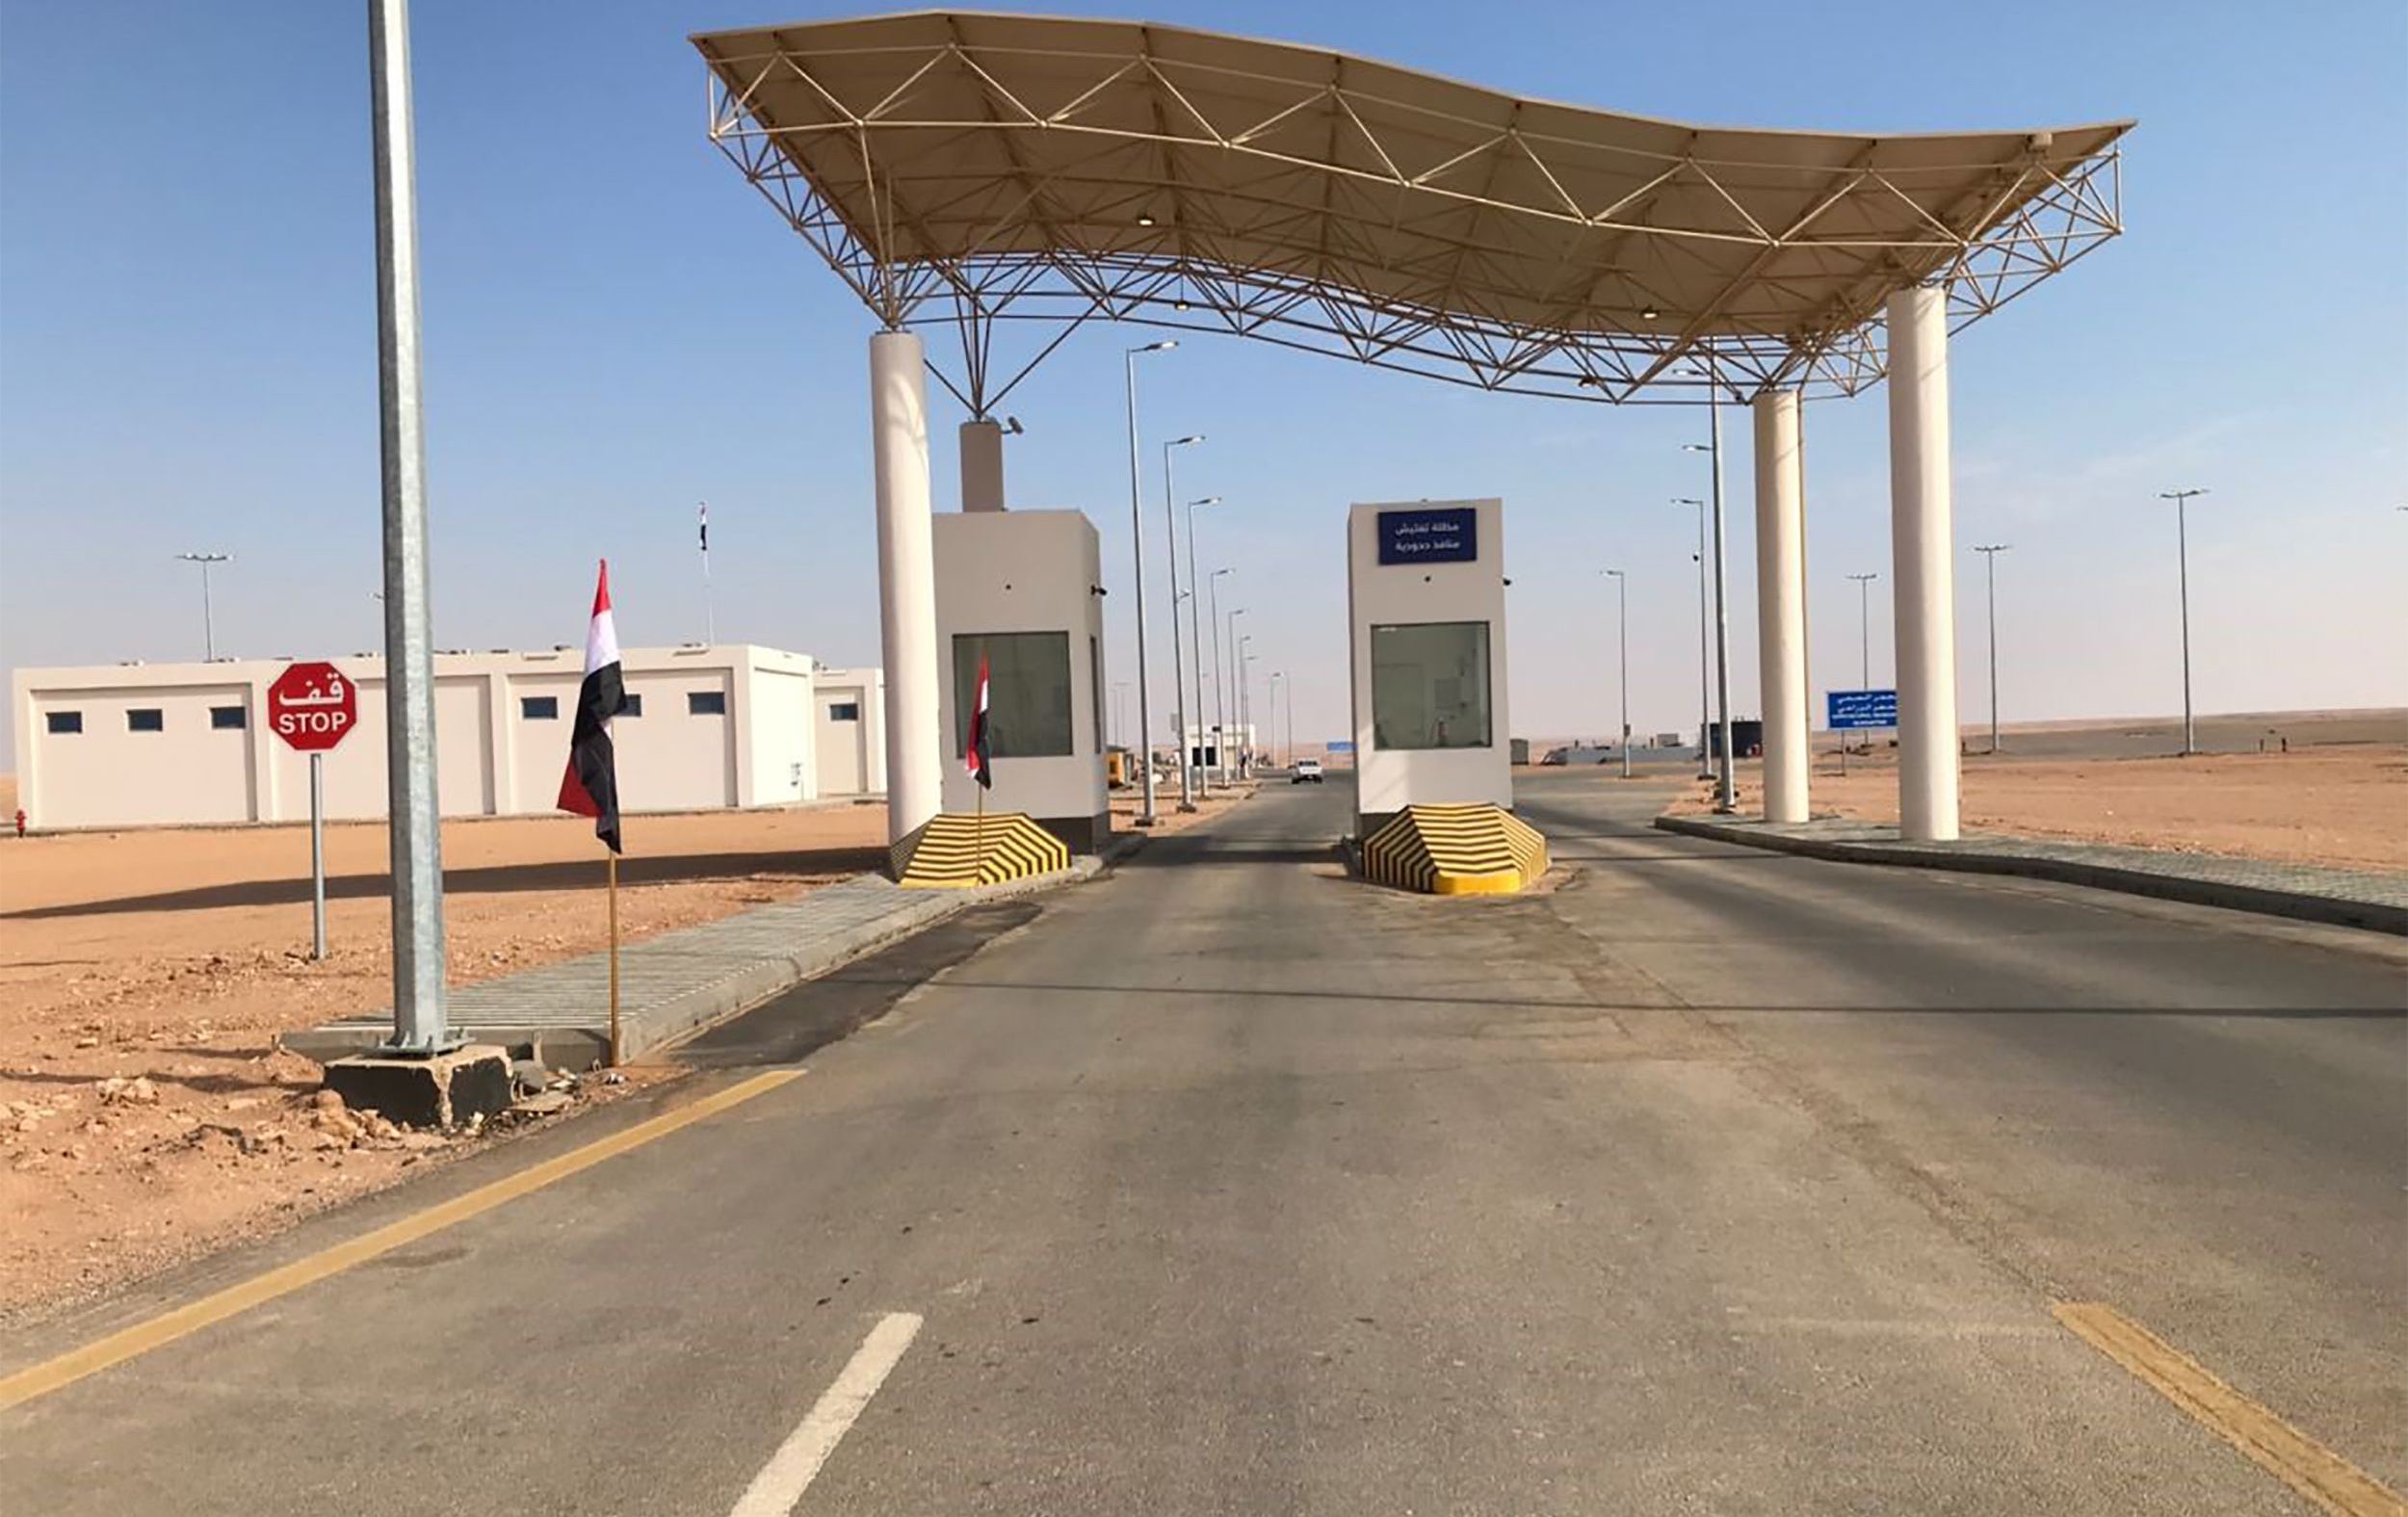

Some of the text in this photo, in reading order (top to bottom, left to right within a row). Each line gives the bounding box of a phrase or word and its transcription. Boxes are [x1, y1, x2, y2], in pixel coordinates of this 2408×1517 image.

[1395, 522, 1429, 536] تفتيش
[1396, 541, 1431, 553] حدودية
[278, 672, 345, 706] قف
[278, 712, 347, 734] STOP
